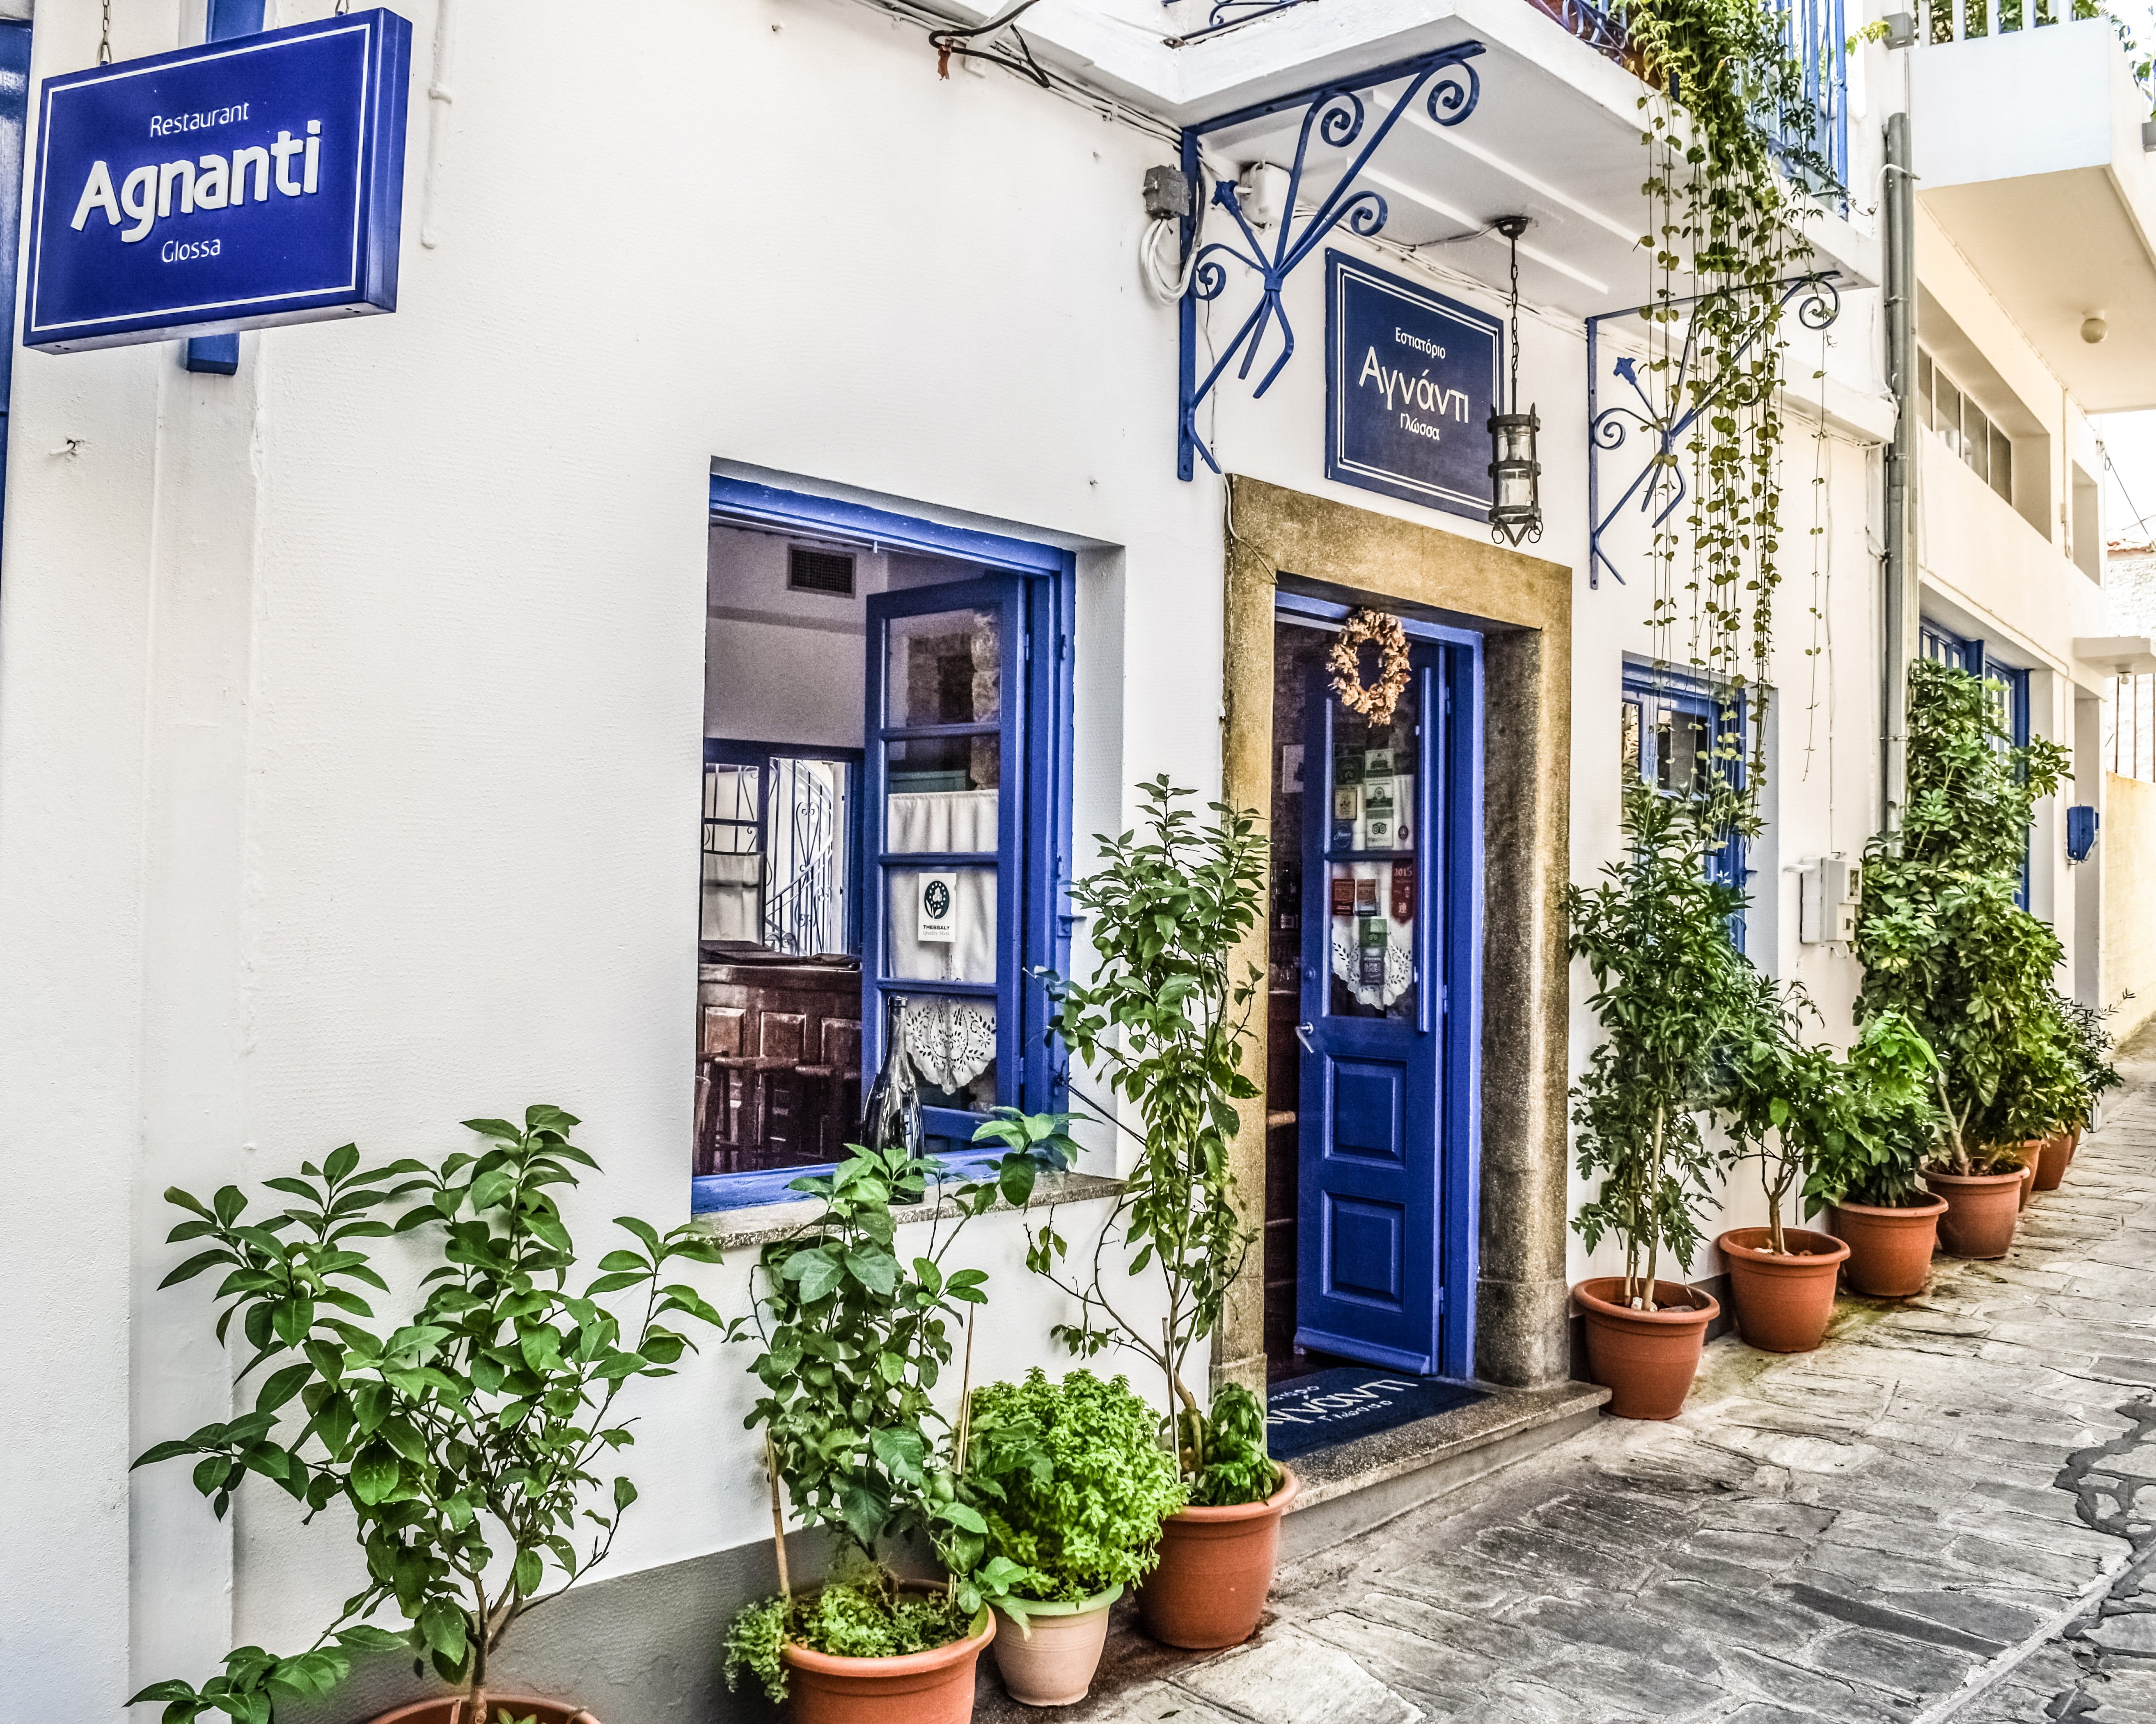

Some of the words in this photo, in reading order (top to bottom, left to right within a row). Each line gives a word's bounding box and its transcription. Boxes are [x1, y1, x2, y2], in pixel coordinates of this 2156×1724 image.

[150, 102, 249, 137] Restaurant
[71, 119, 322, 243] Agnanti
[162, 239, 221, 263] Glossa
[1395, 327, 1446, 359] Εστιατόριο
[1359, 346, 1469, 423] Αγνάντι
[1400, 413, 1440, 441] Γλώσσα
[1394, 866, 1413, 877] 2015
